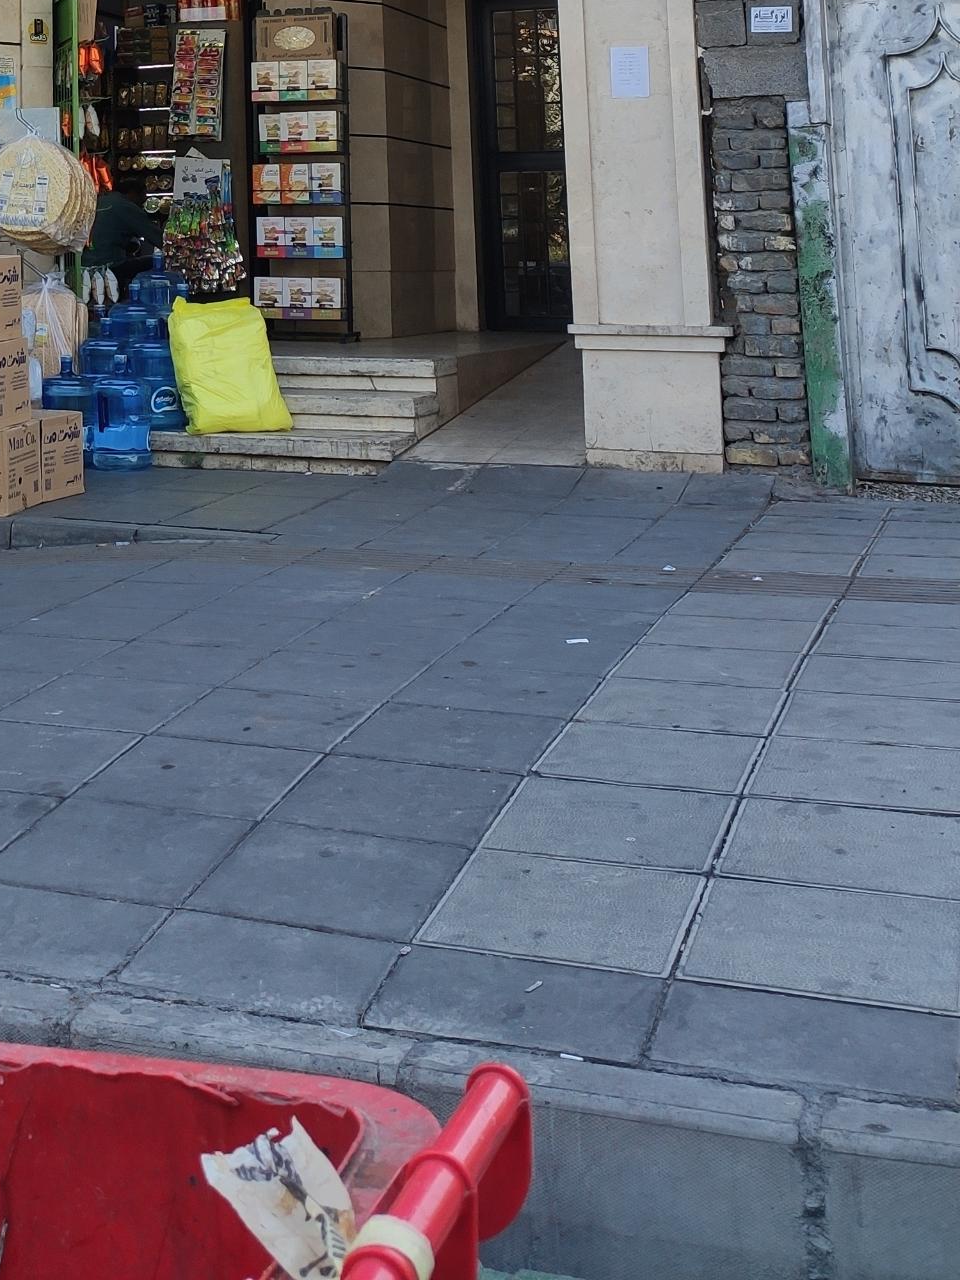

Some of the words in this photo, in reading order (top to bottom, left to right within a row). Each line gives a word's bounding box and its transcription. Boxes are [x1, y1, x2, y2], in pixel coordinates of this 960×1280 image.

[44, 432, 57, 445] من
[58, 422, 81, 442] شرکت
[8, 437, 25, 453] Man
[26, 432, 36, 445] Co.
